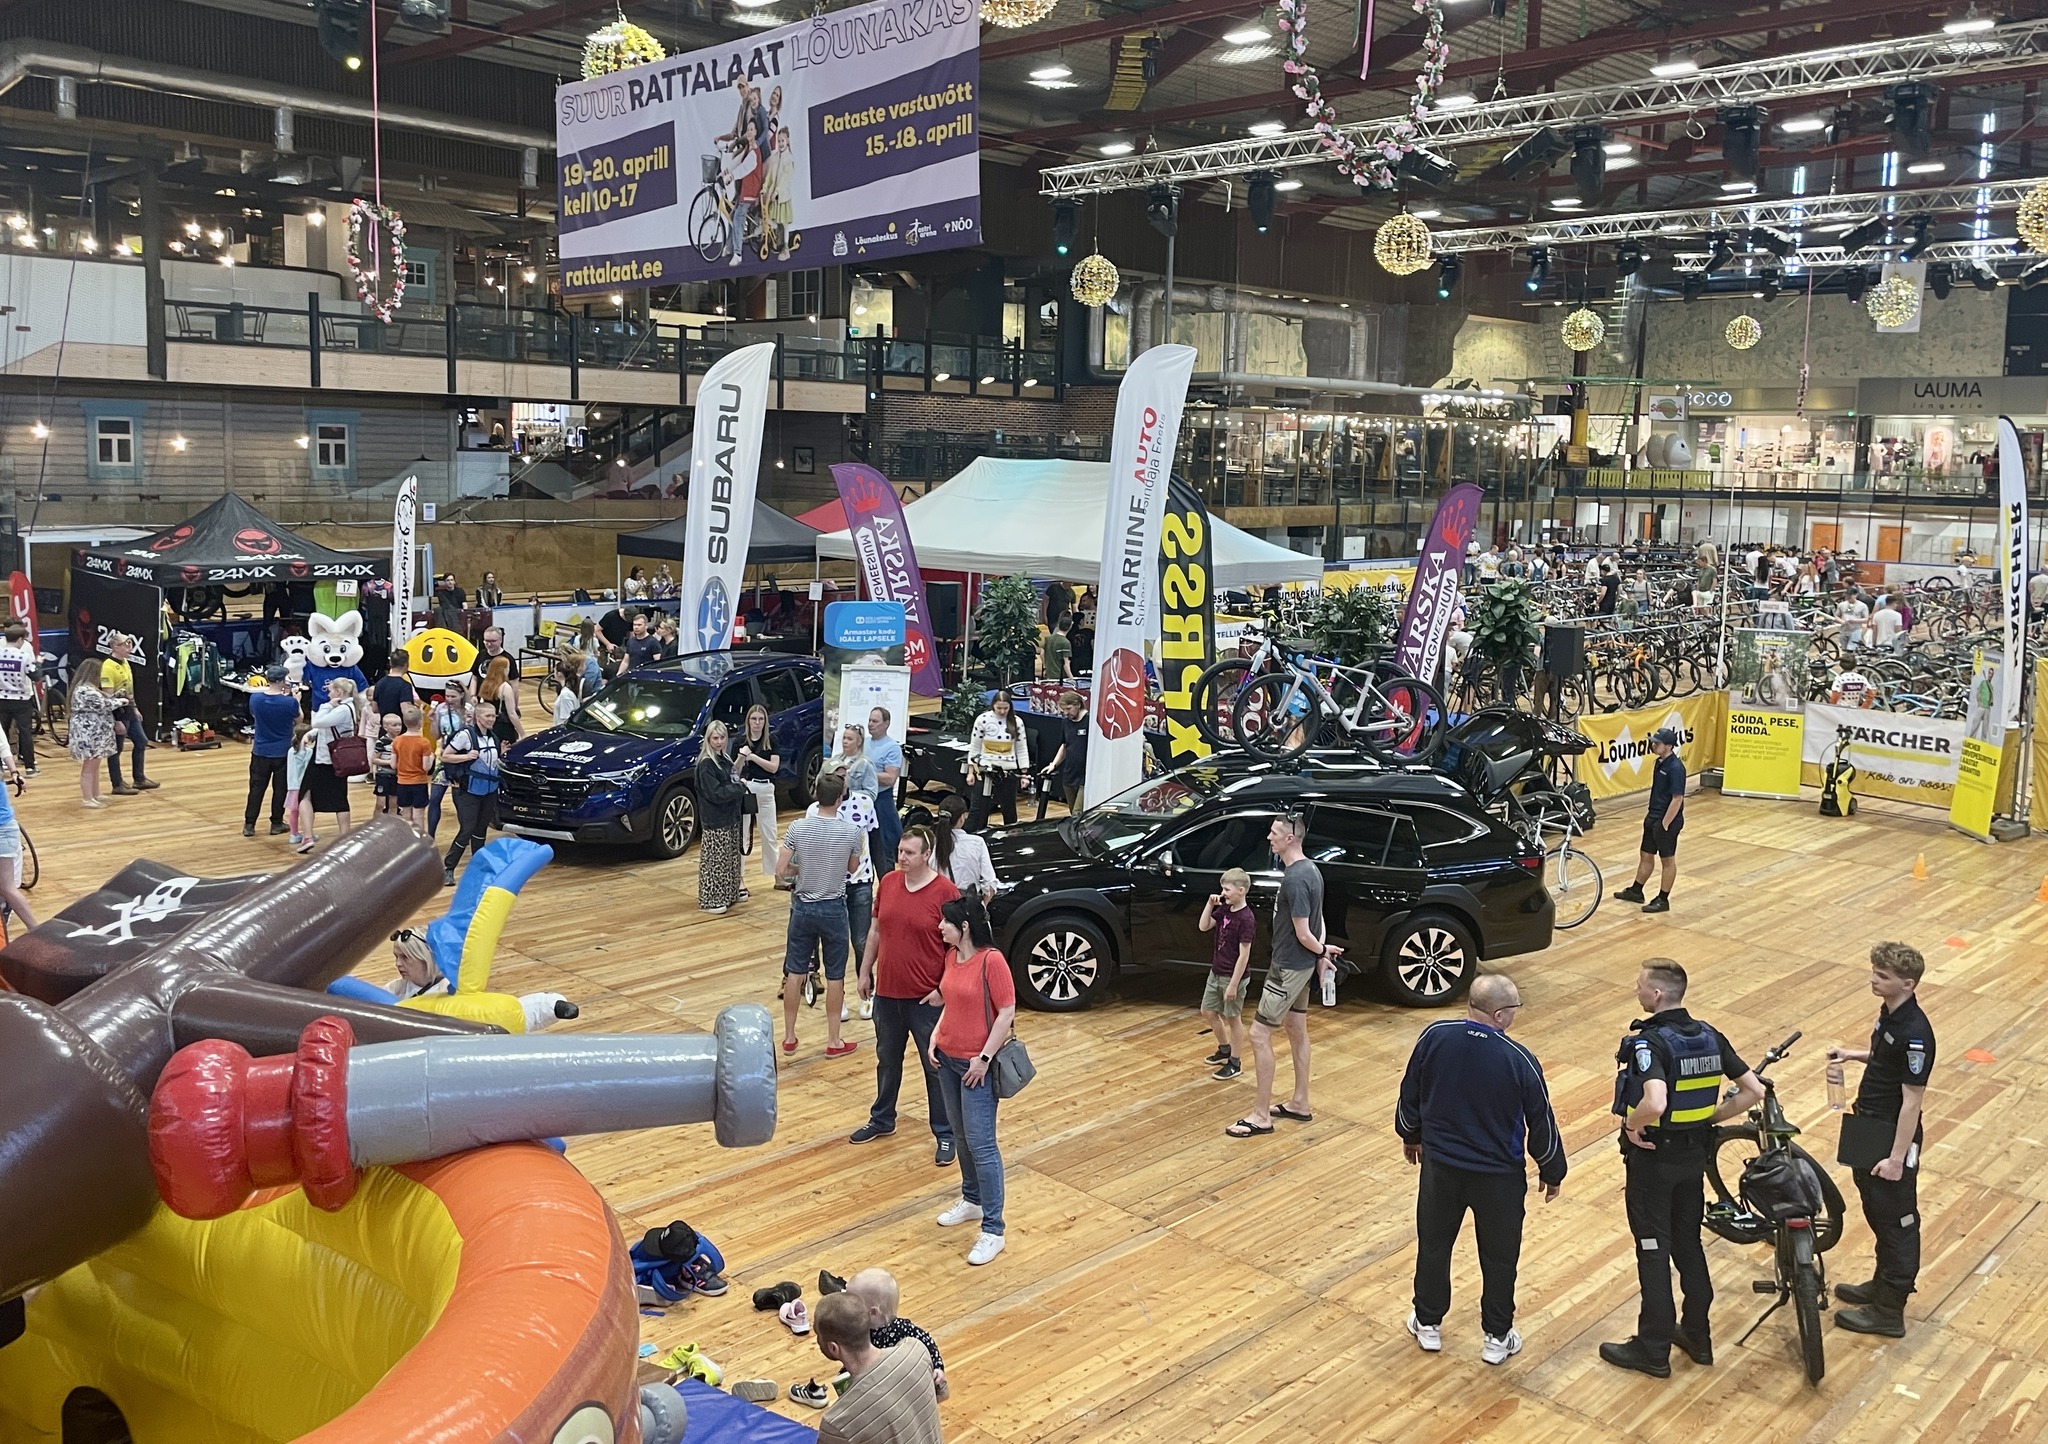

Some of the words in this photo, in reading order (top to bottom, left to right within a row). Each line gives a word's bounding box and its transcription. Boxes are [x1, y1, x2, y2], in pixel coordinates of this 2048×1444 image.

[561, 84, 627, 126] SUUR
[627, 41, 785, 111] RATTALAAT
[791, 0, 973, 71] LÕUNAKAS
[823, 106, 886, 135] Rataste
[888, 81, 973, 120] vastuvõtt
[865, 126, 923, 157] 15.-18.
[926, 113, 973, 146] aprill
[564, 156, 620, 187] 19.-20.
[622, 145, 669, 180] aprill
[564, 191, 591, 217] kell
[593, 183, 638, 212] 10-17
[951, 217, 973, 232] NÕO
[854, 232, 898, 246] Lõunakeskus
[565, 259, 663, 288] rattalaat.ee
[1914, 382, 1982, 398] LAUMA
[1134, 406, 1158, 486] AUTO
[708, 383, 742, 564] SUBARU
[86, 556, 113, 572] 24MX
[313, 564, 375, 576] 24MX
[125, 565, 153, 581] 24MX
[208, 565, 276, 581] 24MX
[343, 584, 351, 592] 17
[1731, 713, 1767, 727] SÕIDA,
[1769, 718, 1799, 729] PESE,
[1730, 725, 1771, 737] KORDA.
[1899, 775, 1916, 785] on
